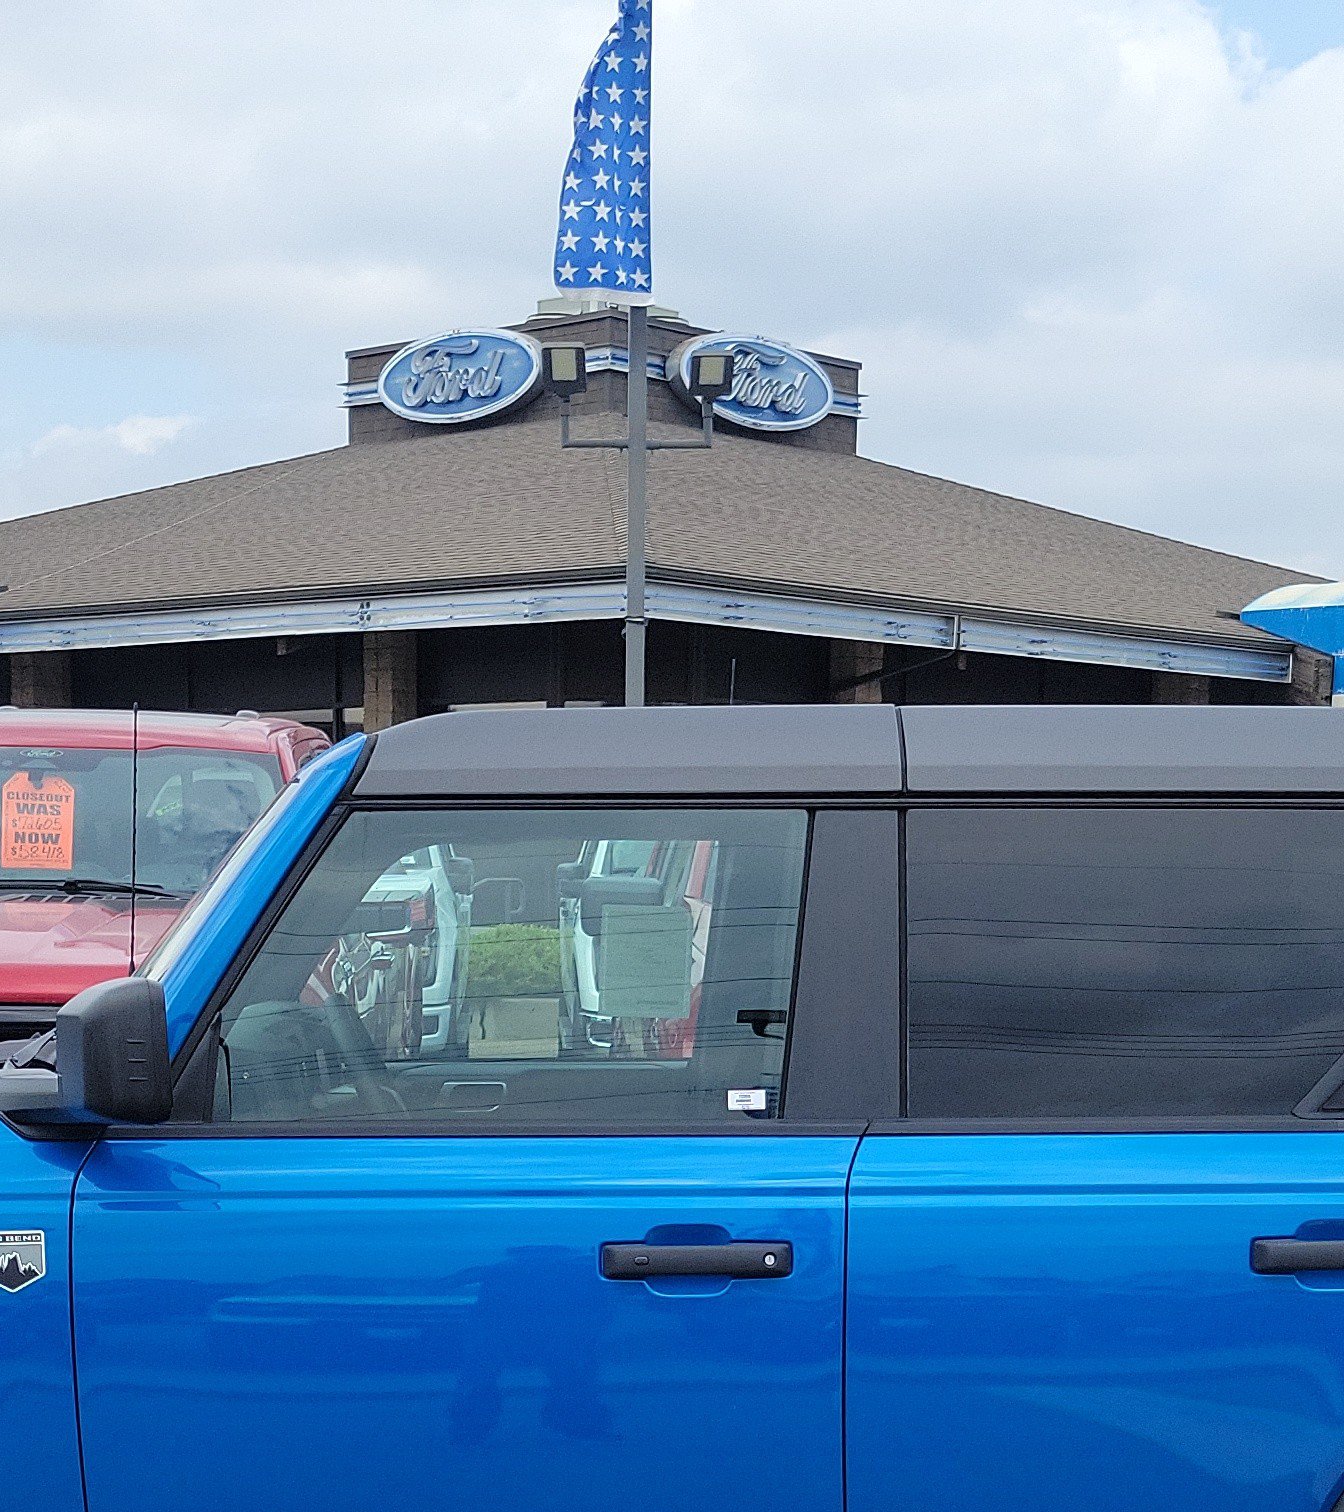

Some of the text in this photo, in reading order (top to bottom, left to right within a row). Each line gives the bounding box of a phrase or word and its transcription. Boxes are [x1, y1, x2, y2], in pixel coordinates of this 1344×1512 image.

[401, 339, 505, 407] Ford
[6, 791, 71, 803] CLOSEOUT
[16, 803, 61, 816] WAS
[14, 831, 61, 845] NOW
